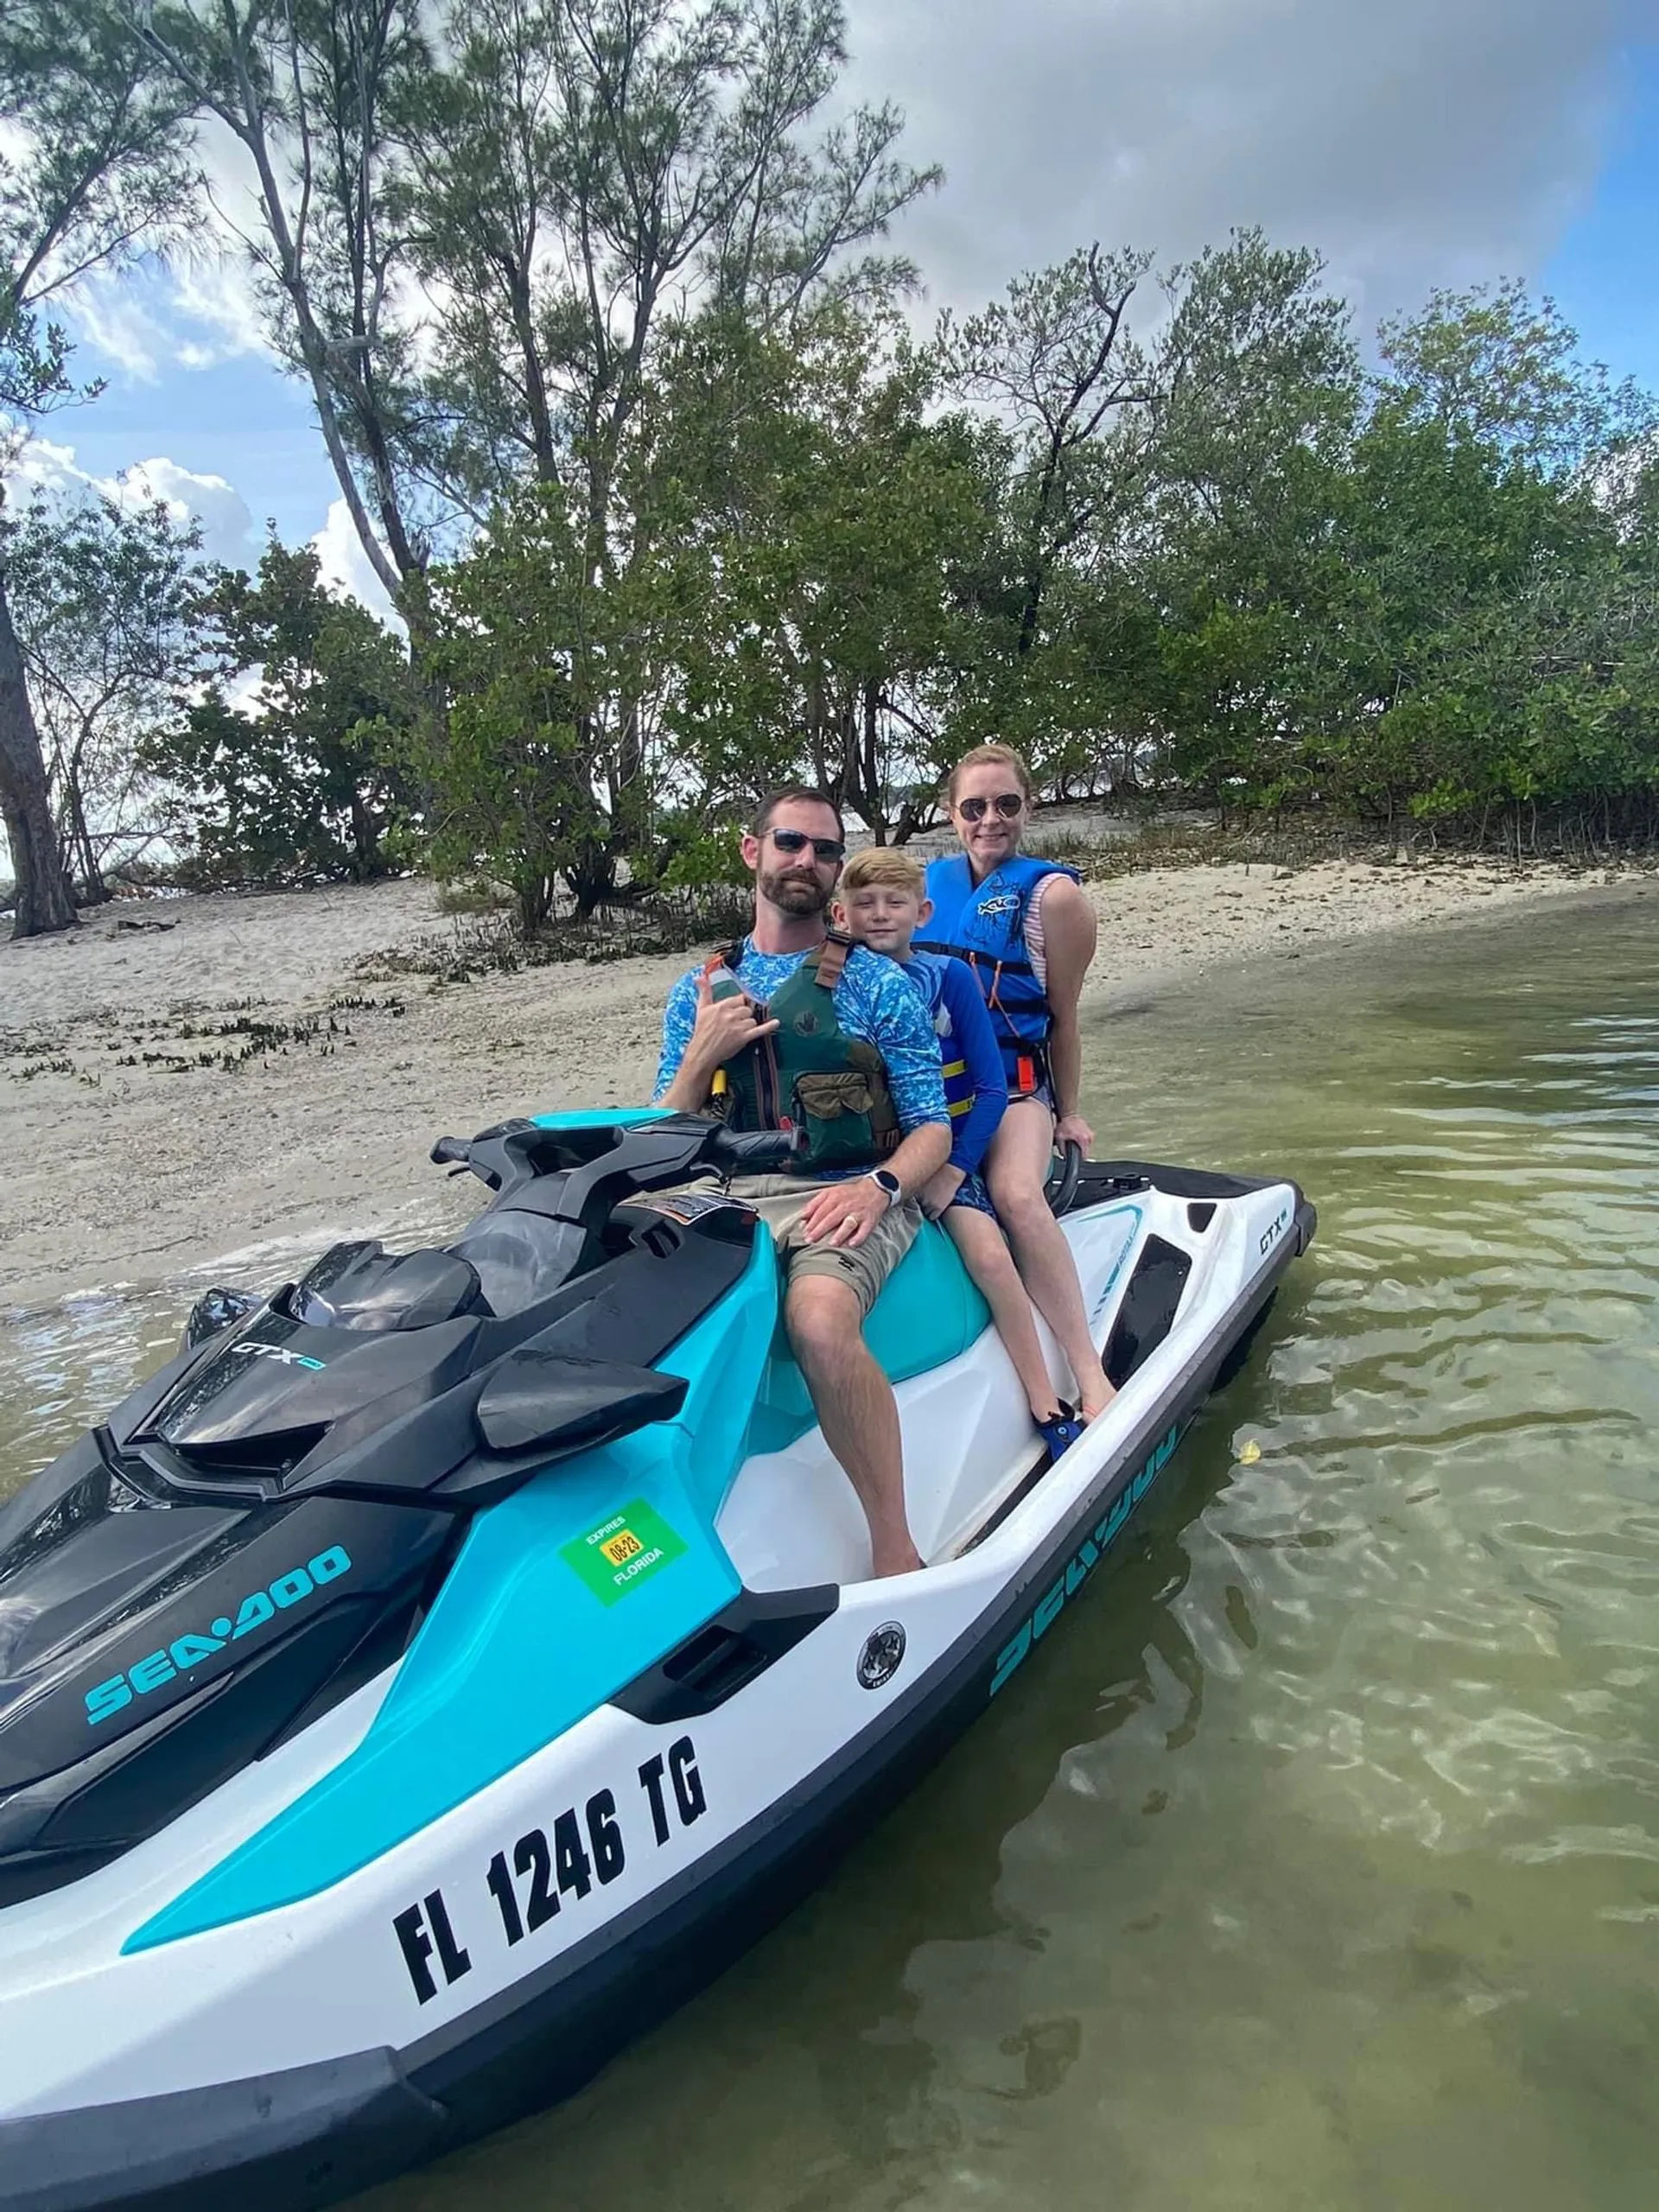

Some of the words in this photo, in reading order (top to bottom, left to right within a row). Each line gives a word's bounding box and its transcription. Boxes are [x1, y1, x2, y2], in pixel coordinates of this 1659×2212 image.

[1260, 1216, 1282, 1255] GTX
[231, 1341, 305, 1365] GTX
[586, 1515, 626, 1546] EXPIRES
[608, 1535, 641, 1562] 08-23
[613, 1547, 664, 1586] FLORIDA
[392, 1888, 473, 2006] FL
[486, 1788, 626, 1948] 1246
[637, 1735, 708, 1848] TG
